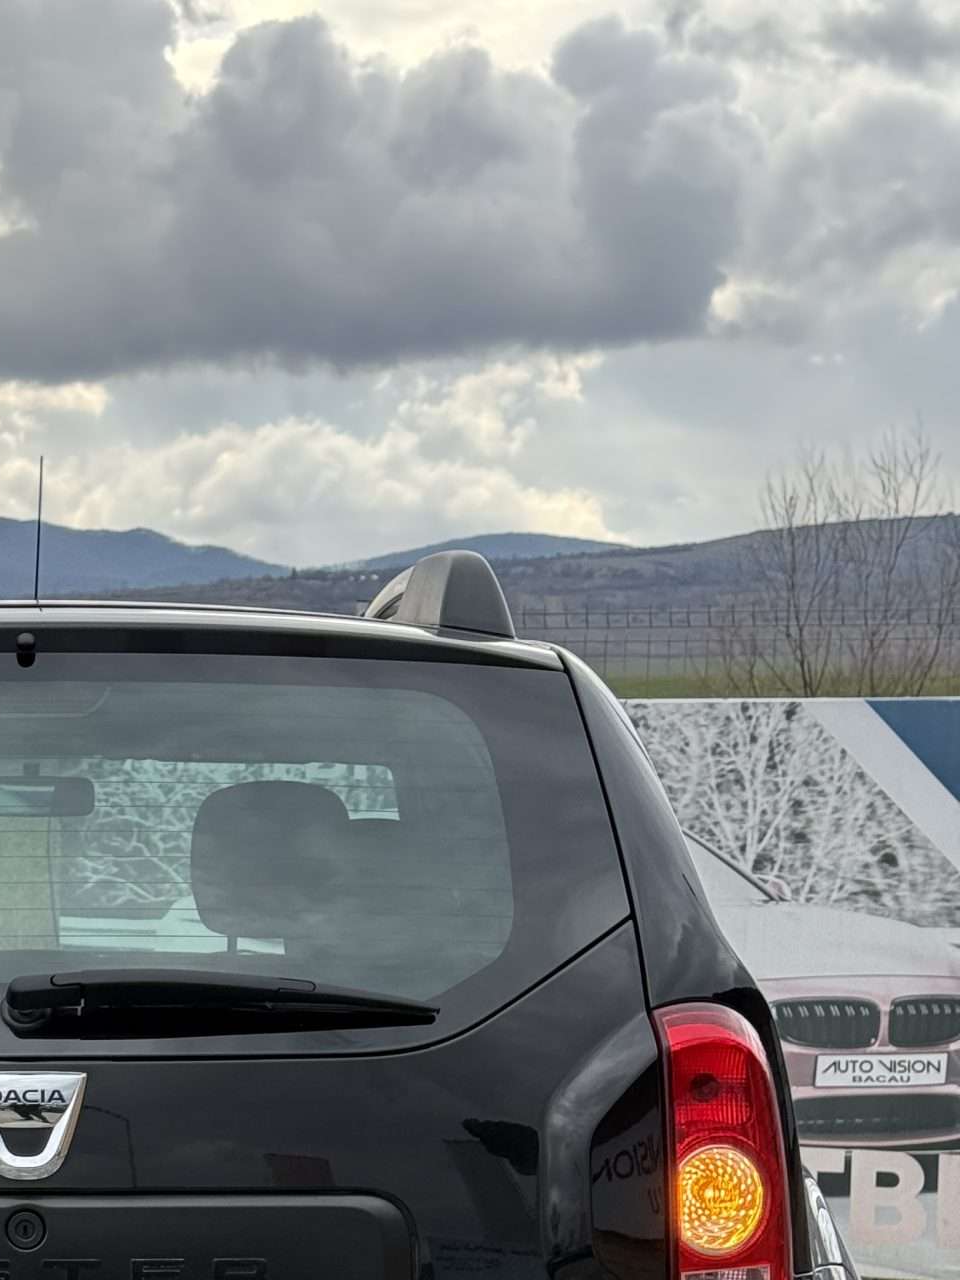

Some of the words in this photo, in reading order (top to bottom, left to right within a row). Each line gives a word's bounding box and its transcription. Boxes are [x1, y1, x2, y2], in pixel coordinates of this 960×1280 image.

[823, 1060, 873, 1073] AUTO
[878, 1059, 941, 1073] VISION
[852, 1075, 911, 1083] BACAU
